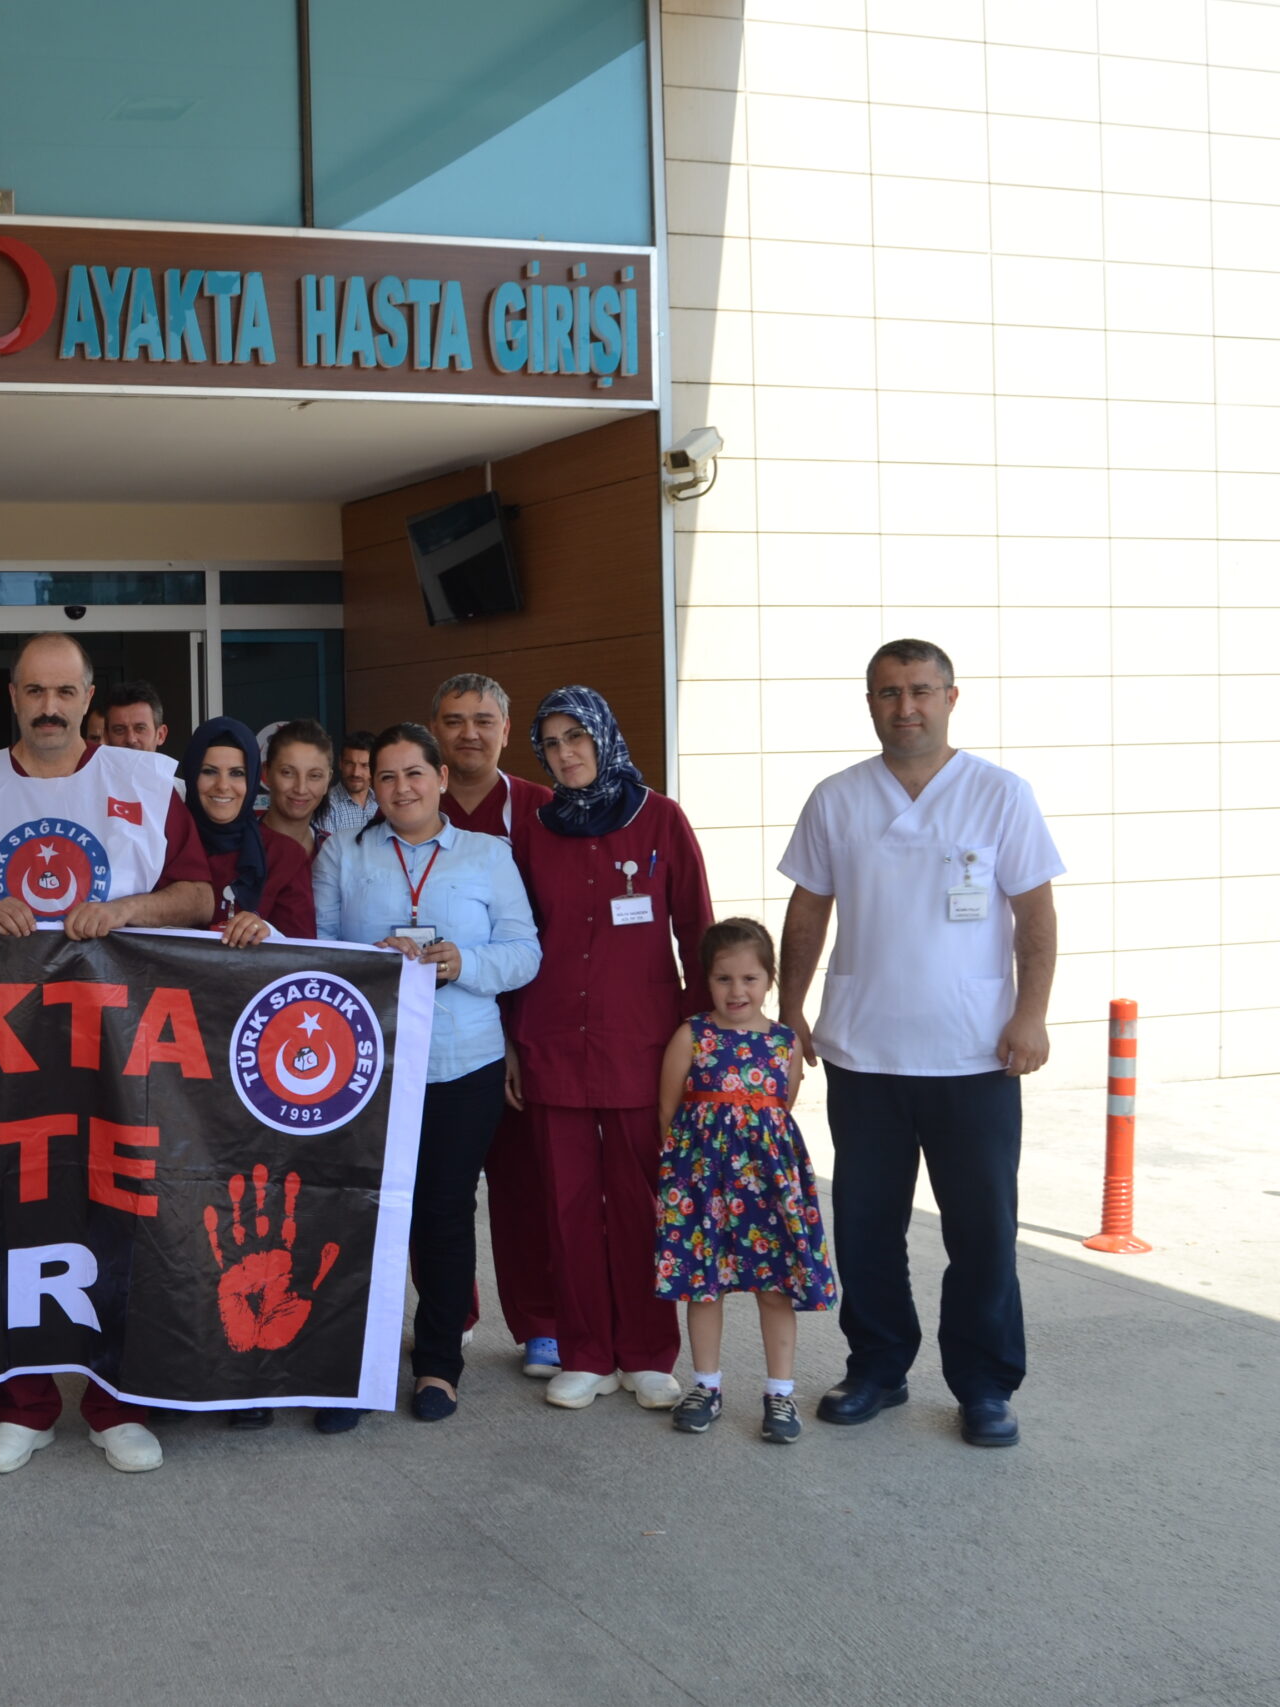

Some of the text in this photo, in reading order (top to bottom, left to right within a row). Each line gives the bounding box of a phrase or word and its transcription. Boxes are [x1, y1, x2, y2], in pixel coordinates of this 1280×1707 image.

[59, 260, 639, 389] AYAKTA HASTA GİRİŞİ
[8, 820, 92, 847] SAĞLIK
[238, 1009, 270, 1088] TÜRK
[269, 978, 361, 1020] SAĞLIK
[348, 1040, 374, 1095] SEN
[279, 1105, 323, 1122] 1992
